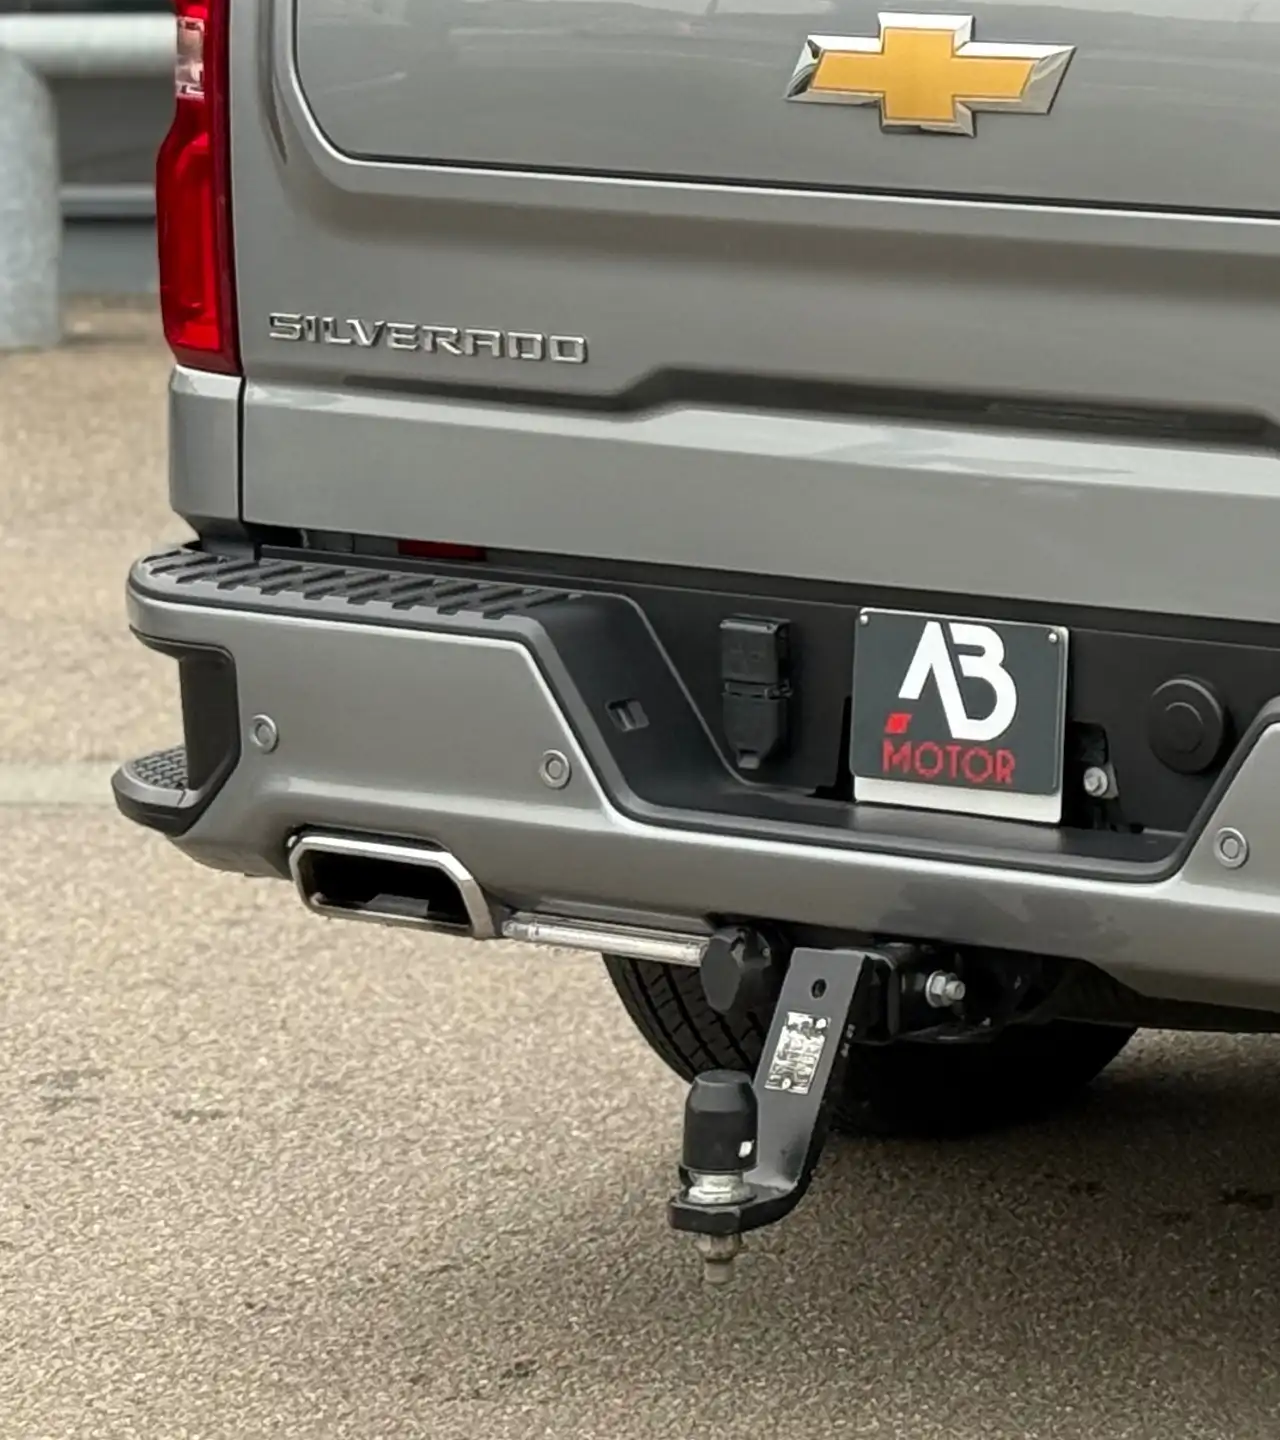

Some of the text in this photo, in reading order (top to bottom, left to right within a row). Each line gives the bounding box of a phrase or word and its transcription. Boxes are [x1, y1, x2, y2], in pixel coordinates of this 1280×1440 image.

[268, 311, 590, 364] SILVERADO
[898, 620, 1018, 742] AB
[882, 739, 1016, 786] MOTOR
